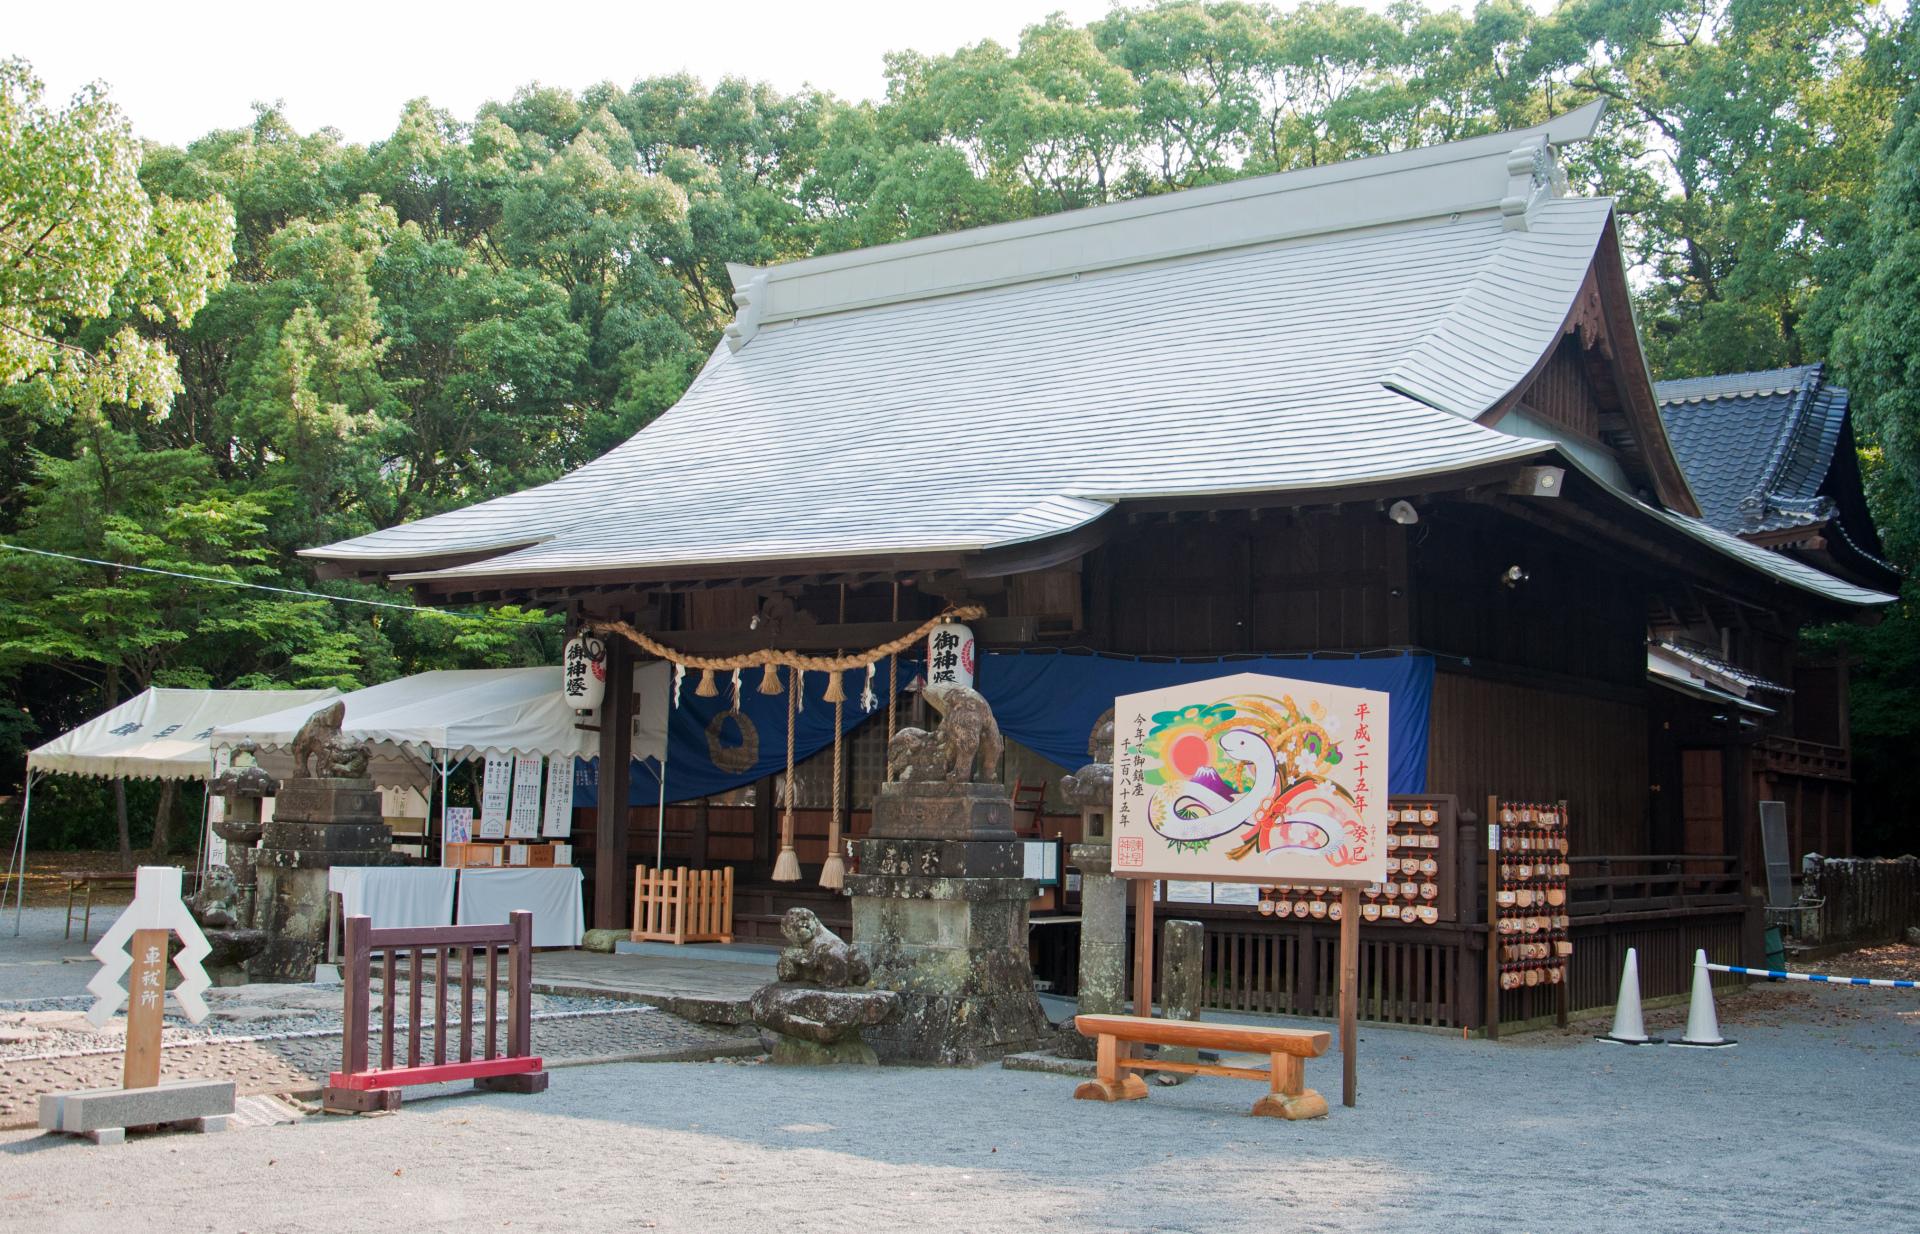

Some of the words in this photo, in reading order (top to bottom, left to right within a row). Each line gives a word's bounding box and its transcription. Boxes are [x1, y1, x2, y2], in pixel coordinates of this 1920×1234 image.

[1119, 738, 1132, 828] 千二百八十五年
[1131, 713, 1147, 797] 今年で御鎮座
[1353, 703, 1371, 813] 平成二十五年
[1352, 825, 1370, 862] 癸巳
[141, 945, 161, 1011] 車祓所
